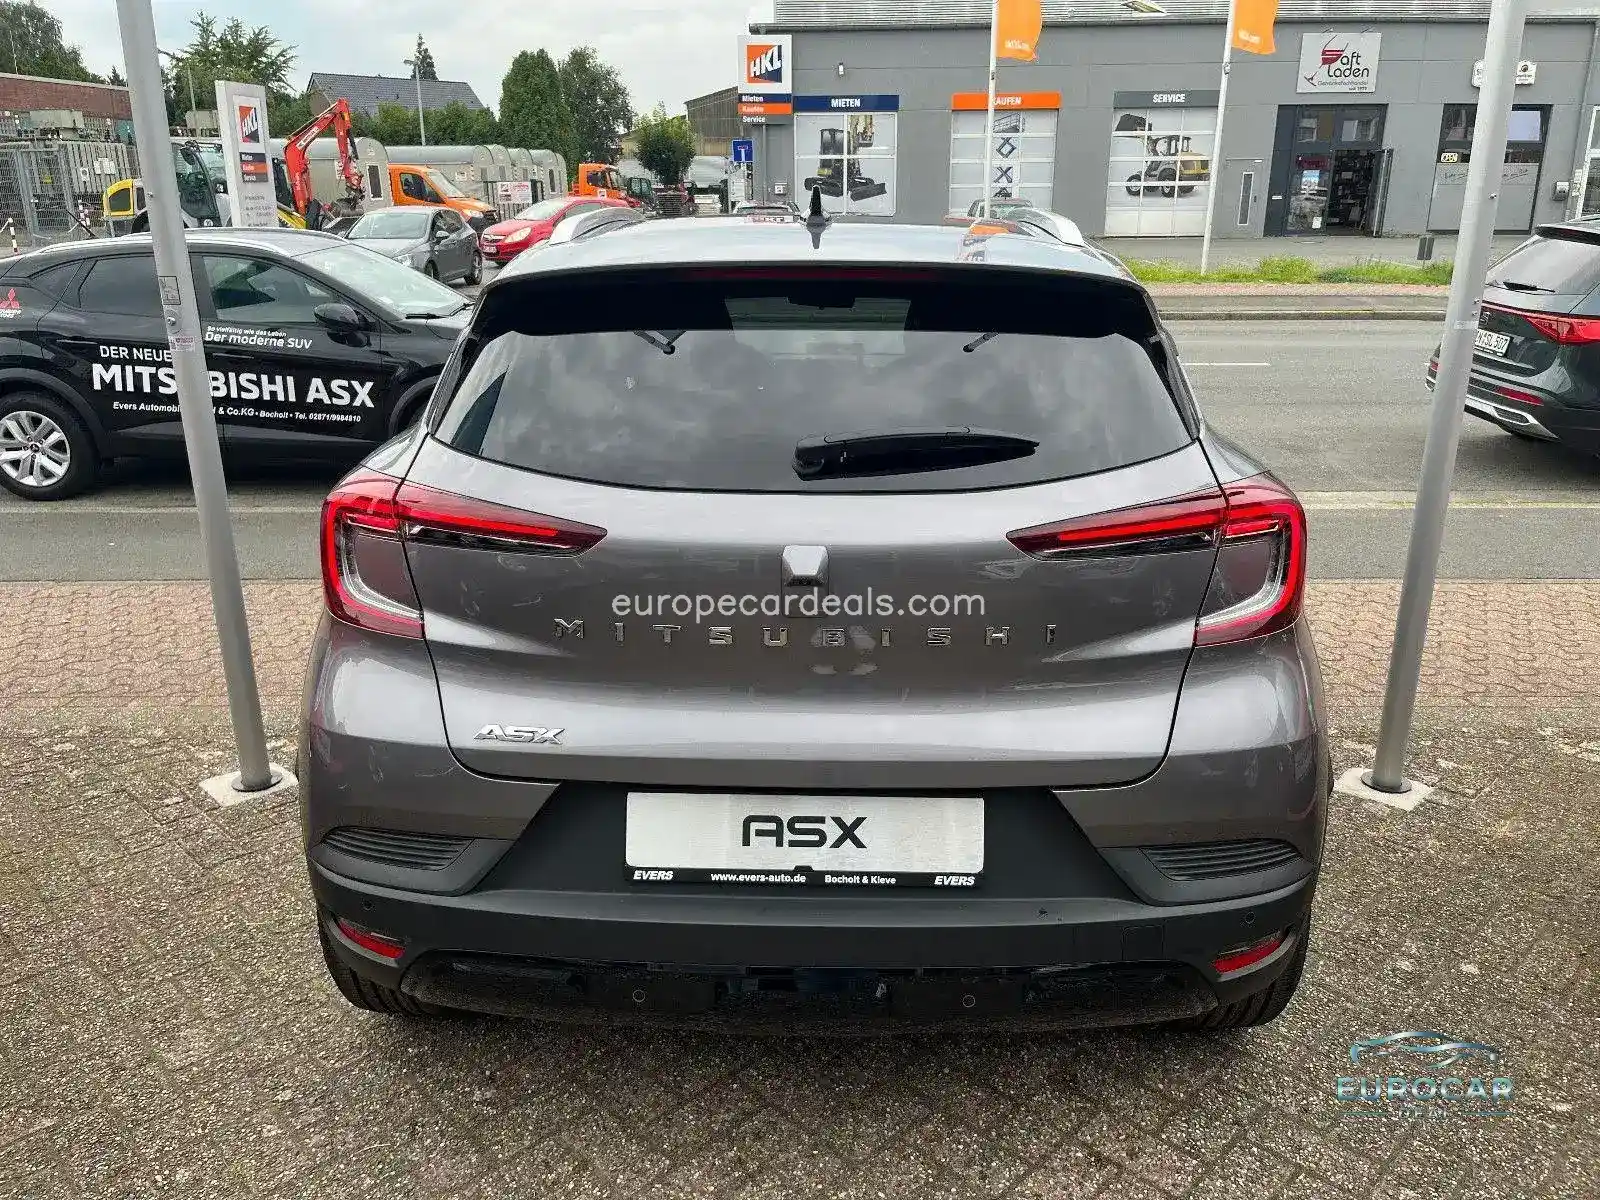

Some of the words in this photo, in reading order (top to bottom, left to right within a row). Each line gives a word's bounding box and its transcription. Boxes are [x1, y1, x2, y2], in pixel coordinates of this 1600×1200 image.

[750, 45, 782, 77] HKL
[831, 98, 861, 108] MIETEN
[1152, 93, 1186, 103] SERVICE
[242, 108, 259, 138] HKL
[742, 115, 766, 123] Service
[205, 331, 227, 342] Der
[229, 334, 285, 347] moderne
[287, 337, 312, 349] SUV
[100, 345, 129, 359] DER
[133, 347, 172, 362] NEUE
[92, 363, 297, 402] MITSBISHI
[306, 377, 375, 408] ASX
[113, 401, 138, 411] Evers
[218, 407, 225, 415] &
[227, 407, 255, 416] Co.KG
[259, 410, 289, 419] Bocholt
[294, 411, 308, 420] Tel.
[553, 618, 1057, 648] MITSUBISHI
[473, 724, 565, 745] ASX
[742, 815, 867, 849] ASX
[633, 870, 674, 881] EVERS
[711, 872, 806, 883] www.evers-auto.de
[825, 874, 860, 884] Bocholt
[861, 875, 869, 884] &
[870, 875, 897, 884] Kleve
[934, 875, 976, 886] EVERS
